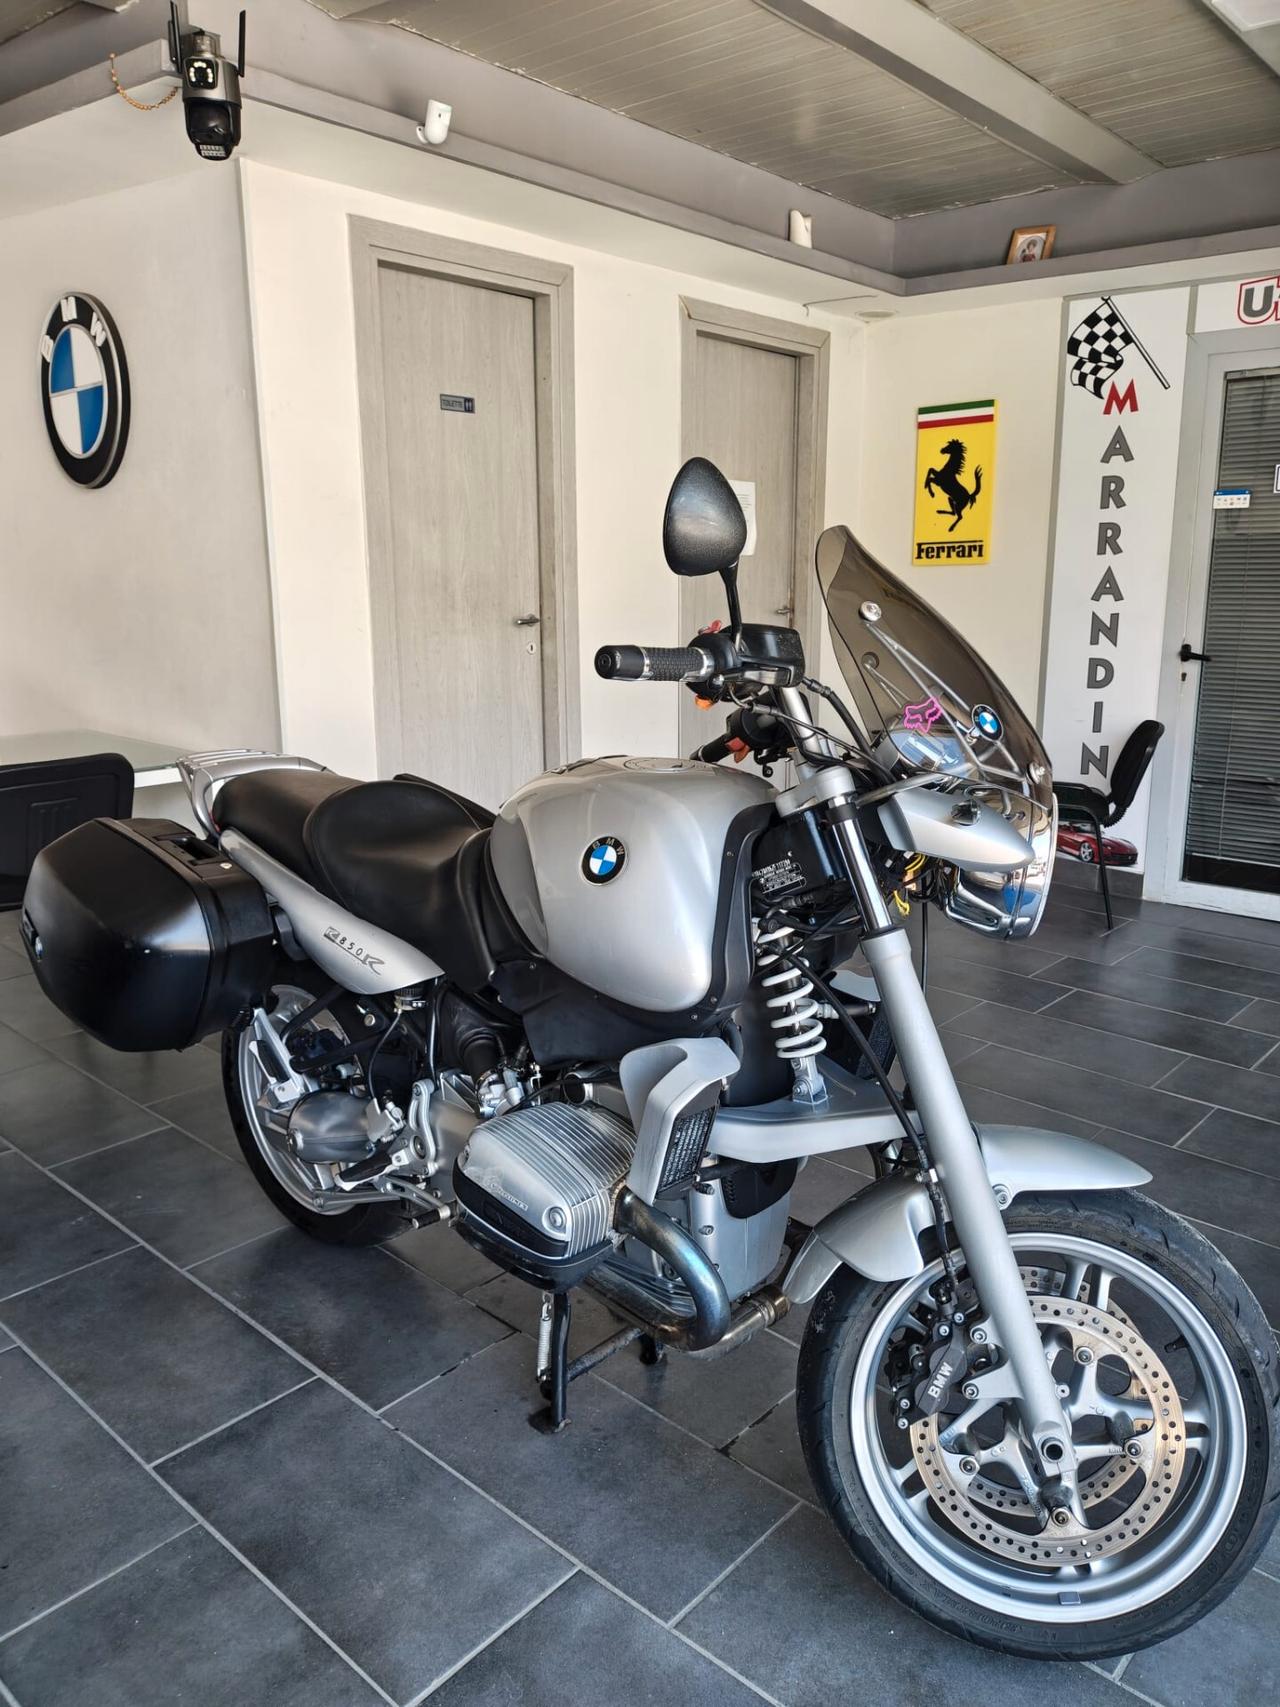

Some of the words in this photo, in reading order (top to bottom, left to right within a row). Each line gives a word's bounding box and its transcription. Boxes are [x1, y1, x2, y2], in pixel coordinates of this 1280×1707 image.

[41, 296, 106, 363] BMW
[915, 540, 984, 559] Ferrari
[592, 837, 625, 855] BMW
[928, 1361, 953, 1398] BMW
